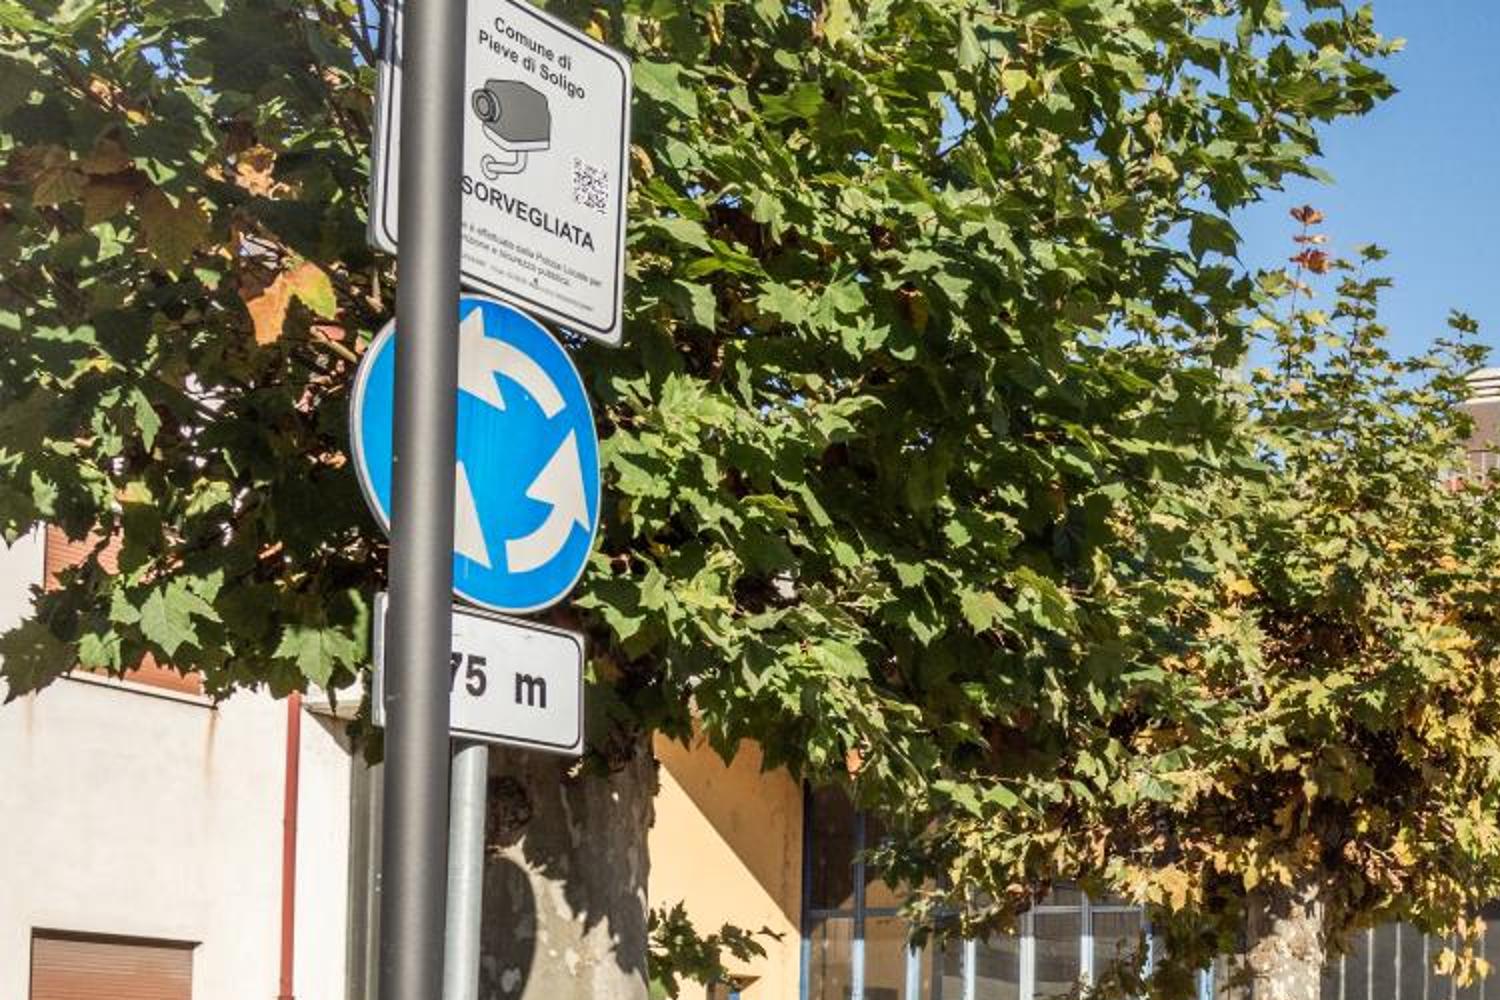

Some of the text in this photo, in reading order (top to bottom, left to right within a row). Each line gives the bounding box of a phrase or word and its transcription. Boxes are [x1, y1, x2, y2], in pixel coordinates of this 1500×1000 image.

[479, 29, 585, 99] Pieve di Soligo
[494, 17, 572, 71] Comune di
[515, 672, 547, 709] m
